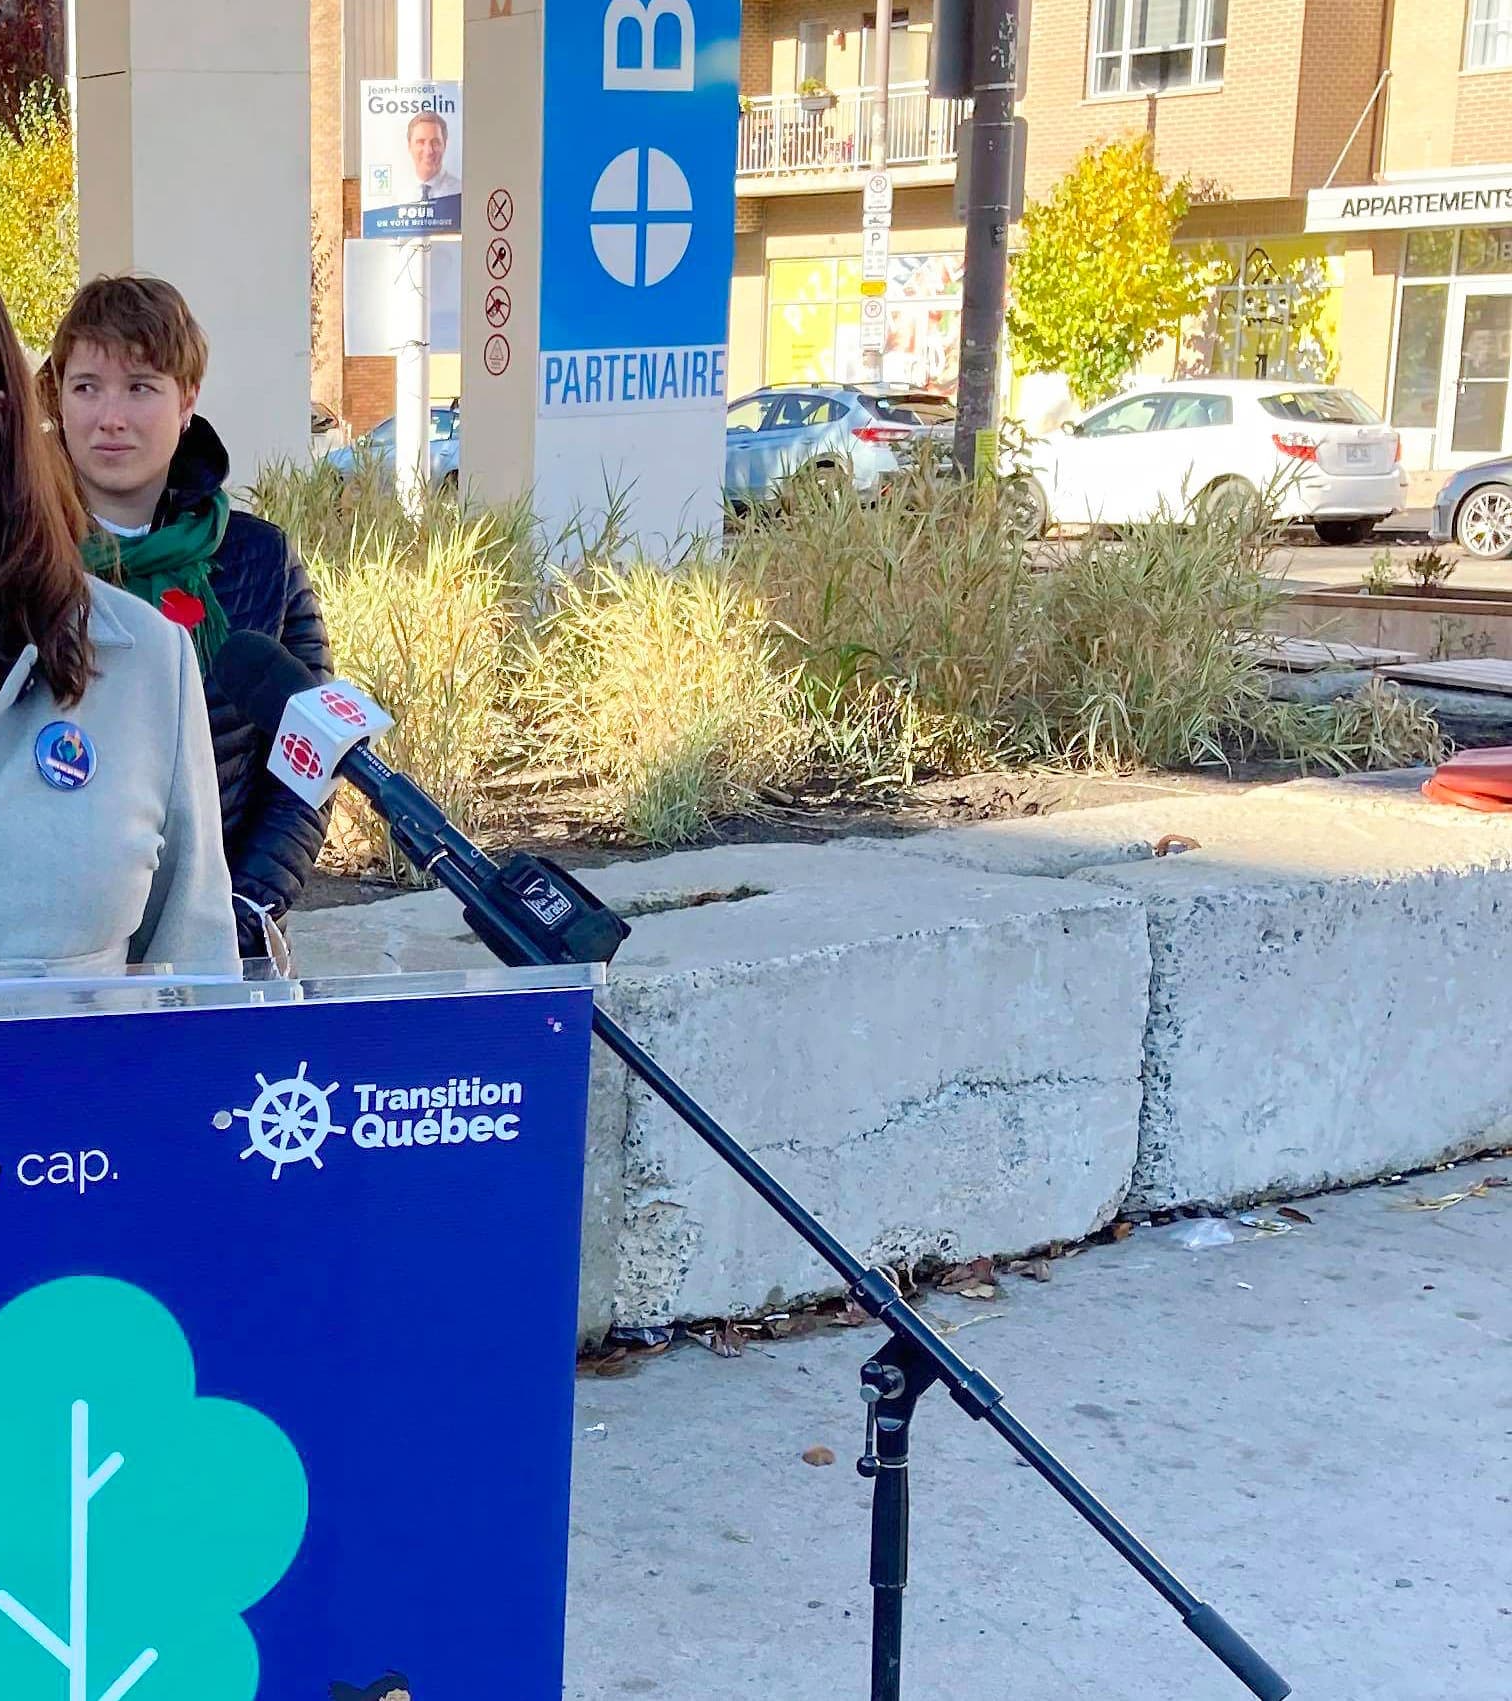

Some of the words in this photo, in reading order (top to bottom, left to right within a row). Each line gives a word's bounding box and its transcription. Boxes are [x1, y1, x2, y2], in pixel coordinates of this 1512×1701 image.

[368, 94, 456, 114] Gosselin
[390, 218, 409, 227] VOTE
[397, 206, 434, 219] POUR
[545, 350, 725, 405] PARTENAIRE
[353, 1076, 522, 1112] Transition
[351, 1109, 521, 1149] Québec
[16, 1148, 119, 1195] cap.
